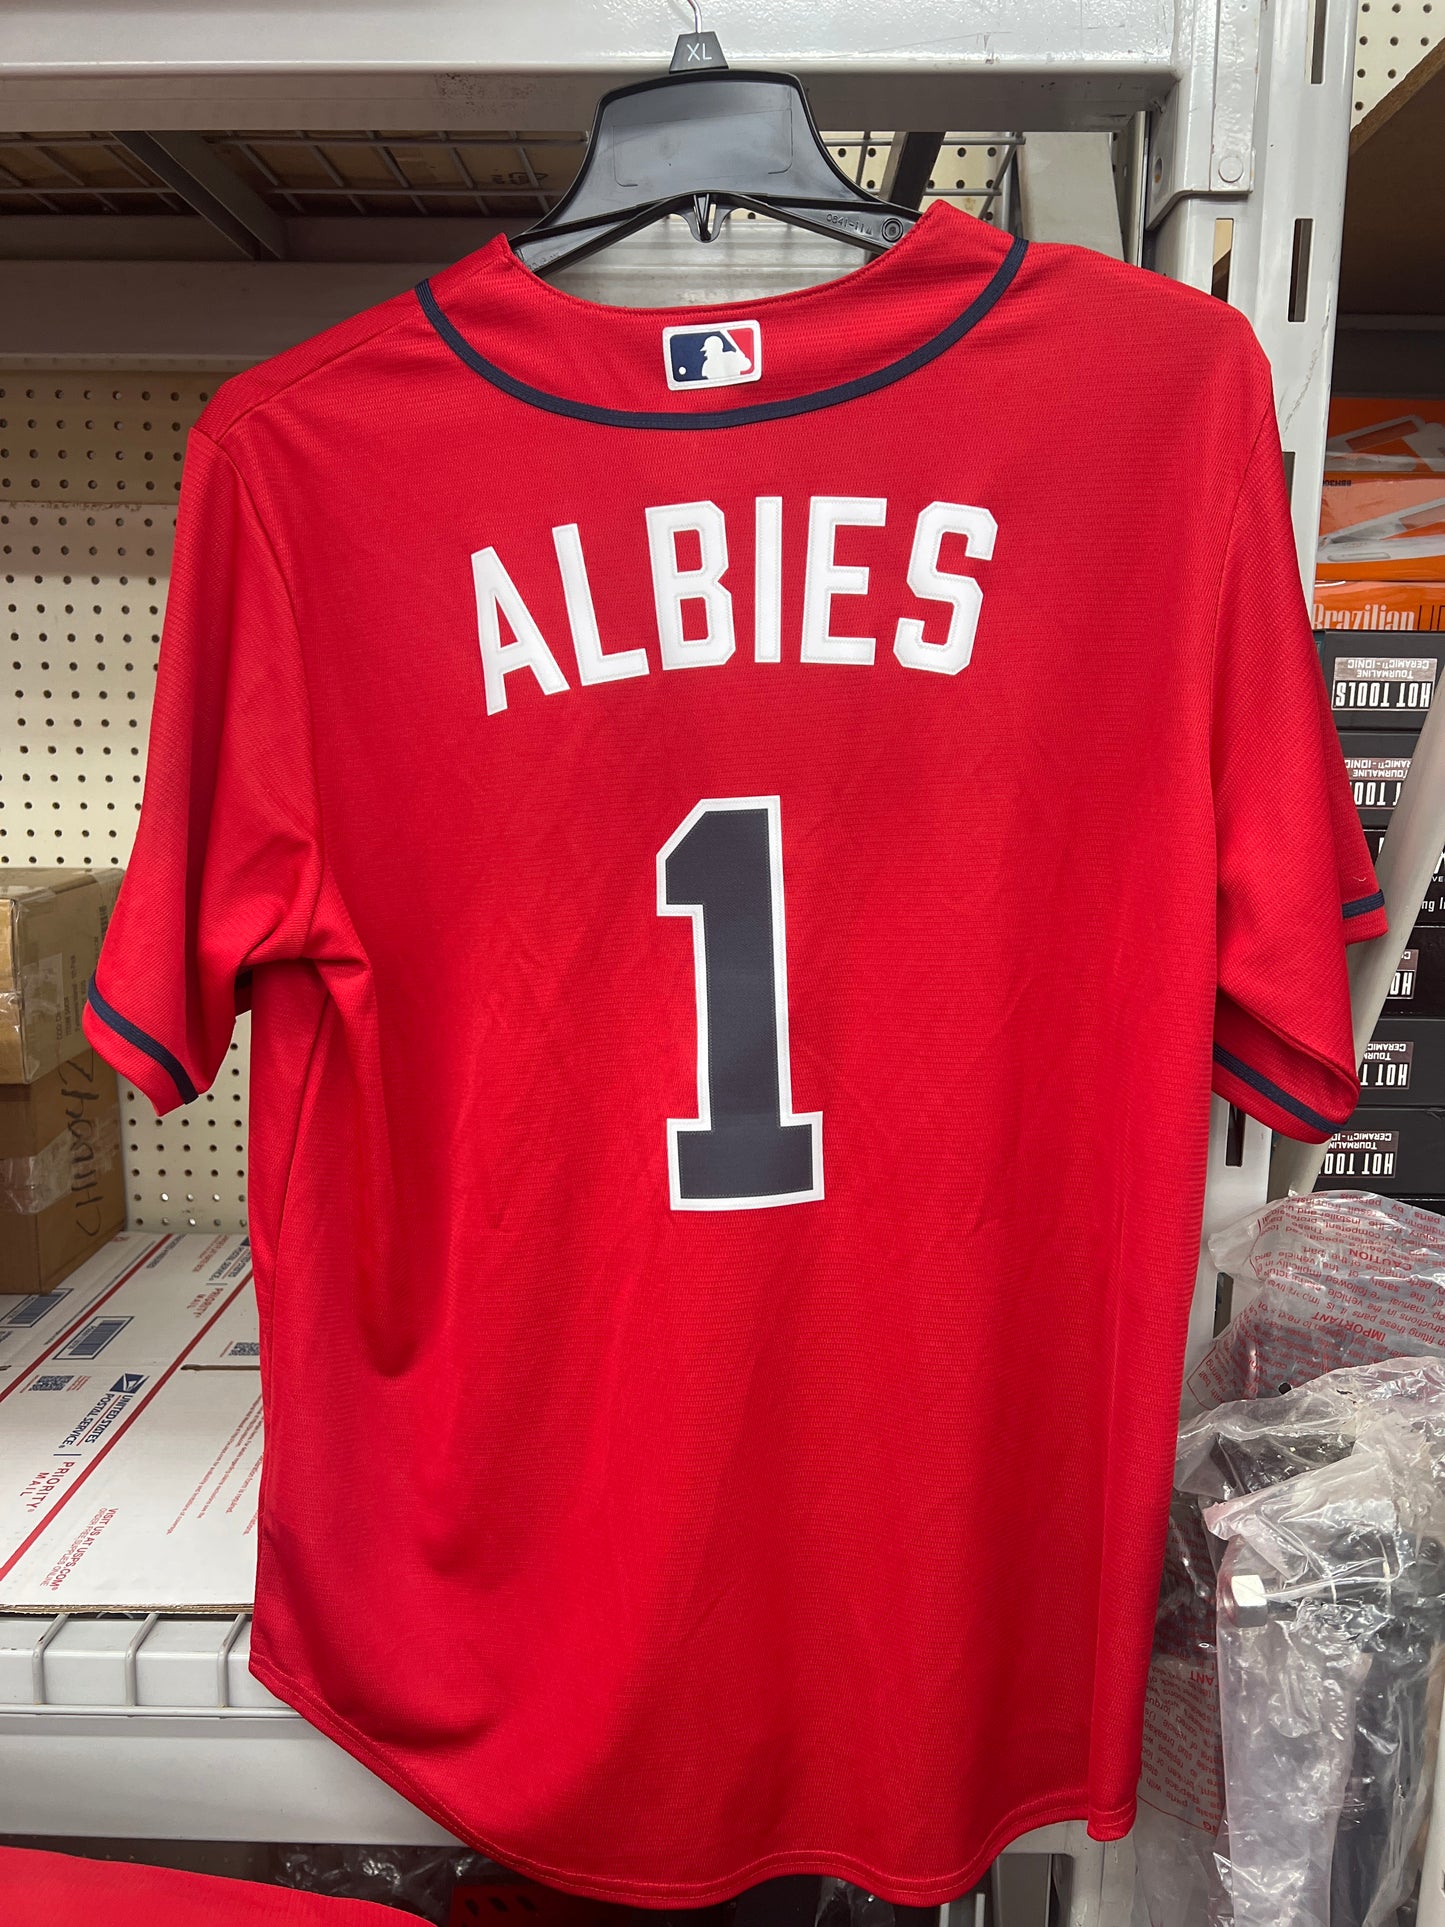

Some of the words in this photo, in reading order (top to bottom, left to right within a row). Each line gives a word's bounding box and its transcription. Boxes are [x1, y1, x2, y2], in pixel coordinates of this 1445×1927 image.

[686, 42, 713, 62] XL
[471, 496, 998, 716] ALBIES
[1312, 603, 1415, 631] Brazilian
[1357, 669, 1414, 679] TOURMALINE
[1335, 682, 1390, 708] TOOLS
[1396, 683, 1432, 708] HOT
[656, 795, 825, 1211] 1
[1375, 1064, 1408, 1086] HOT
[1361, 1153, 1394, 1175] HOT
[1255, 1251, 1273, 1261] and
[1278, 1251, 1316, 1265] vehicle
[1331, 1253, 1348, 1264] the
[1349, 1248, 1412, 1271] CAUTION
[1348, 1269, 1359, 1278] of
[1325, 1275, 1368, 1297] followed
[1369, 1277, 1400, 1293] safety
[1328, 1288, 1363, 1307] vehicle
[1410, 1291, 1426, 1303] the
[1326, 1302, 1335, 1311] is
[1340, 1307, 1348, 1315] it
[1367, 1302, 1383, 1313] the
[1387, 1308, 1397, 1316] in
[1389, 1298, 1426, 1315] manual
[1352, 1310, 1378, 1322] parts
[1312, 1311, 1386, 1343] IMPORTANT
[1379, 1318, 1406, 1334] these
[1409, 1327, 1435, 1344] fitting
[87, 1393, 115, 1418] POSTAL
[106, 1394, 133, 1420] UNITED
[84, 1419, 112, 1444] STATES
[19, 1472, 50, 1497] MAIL
[99, 1507, 119, 1525] VISIT
[90, 1525, 105, 1537] US
[82, 1537, 96, 1547] AT
[1146, 1777, 1162, 1793] with
